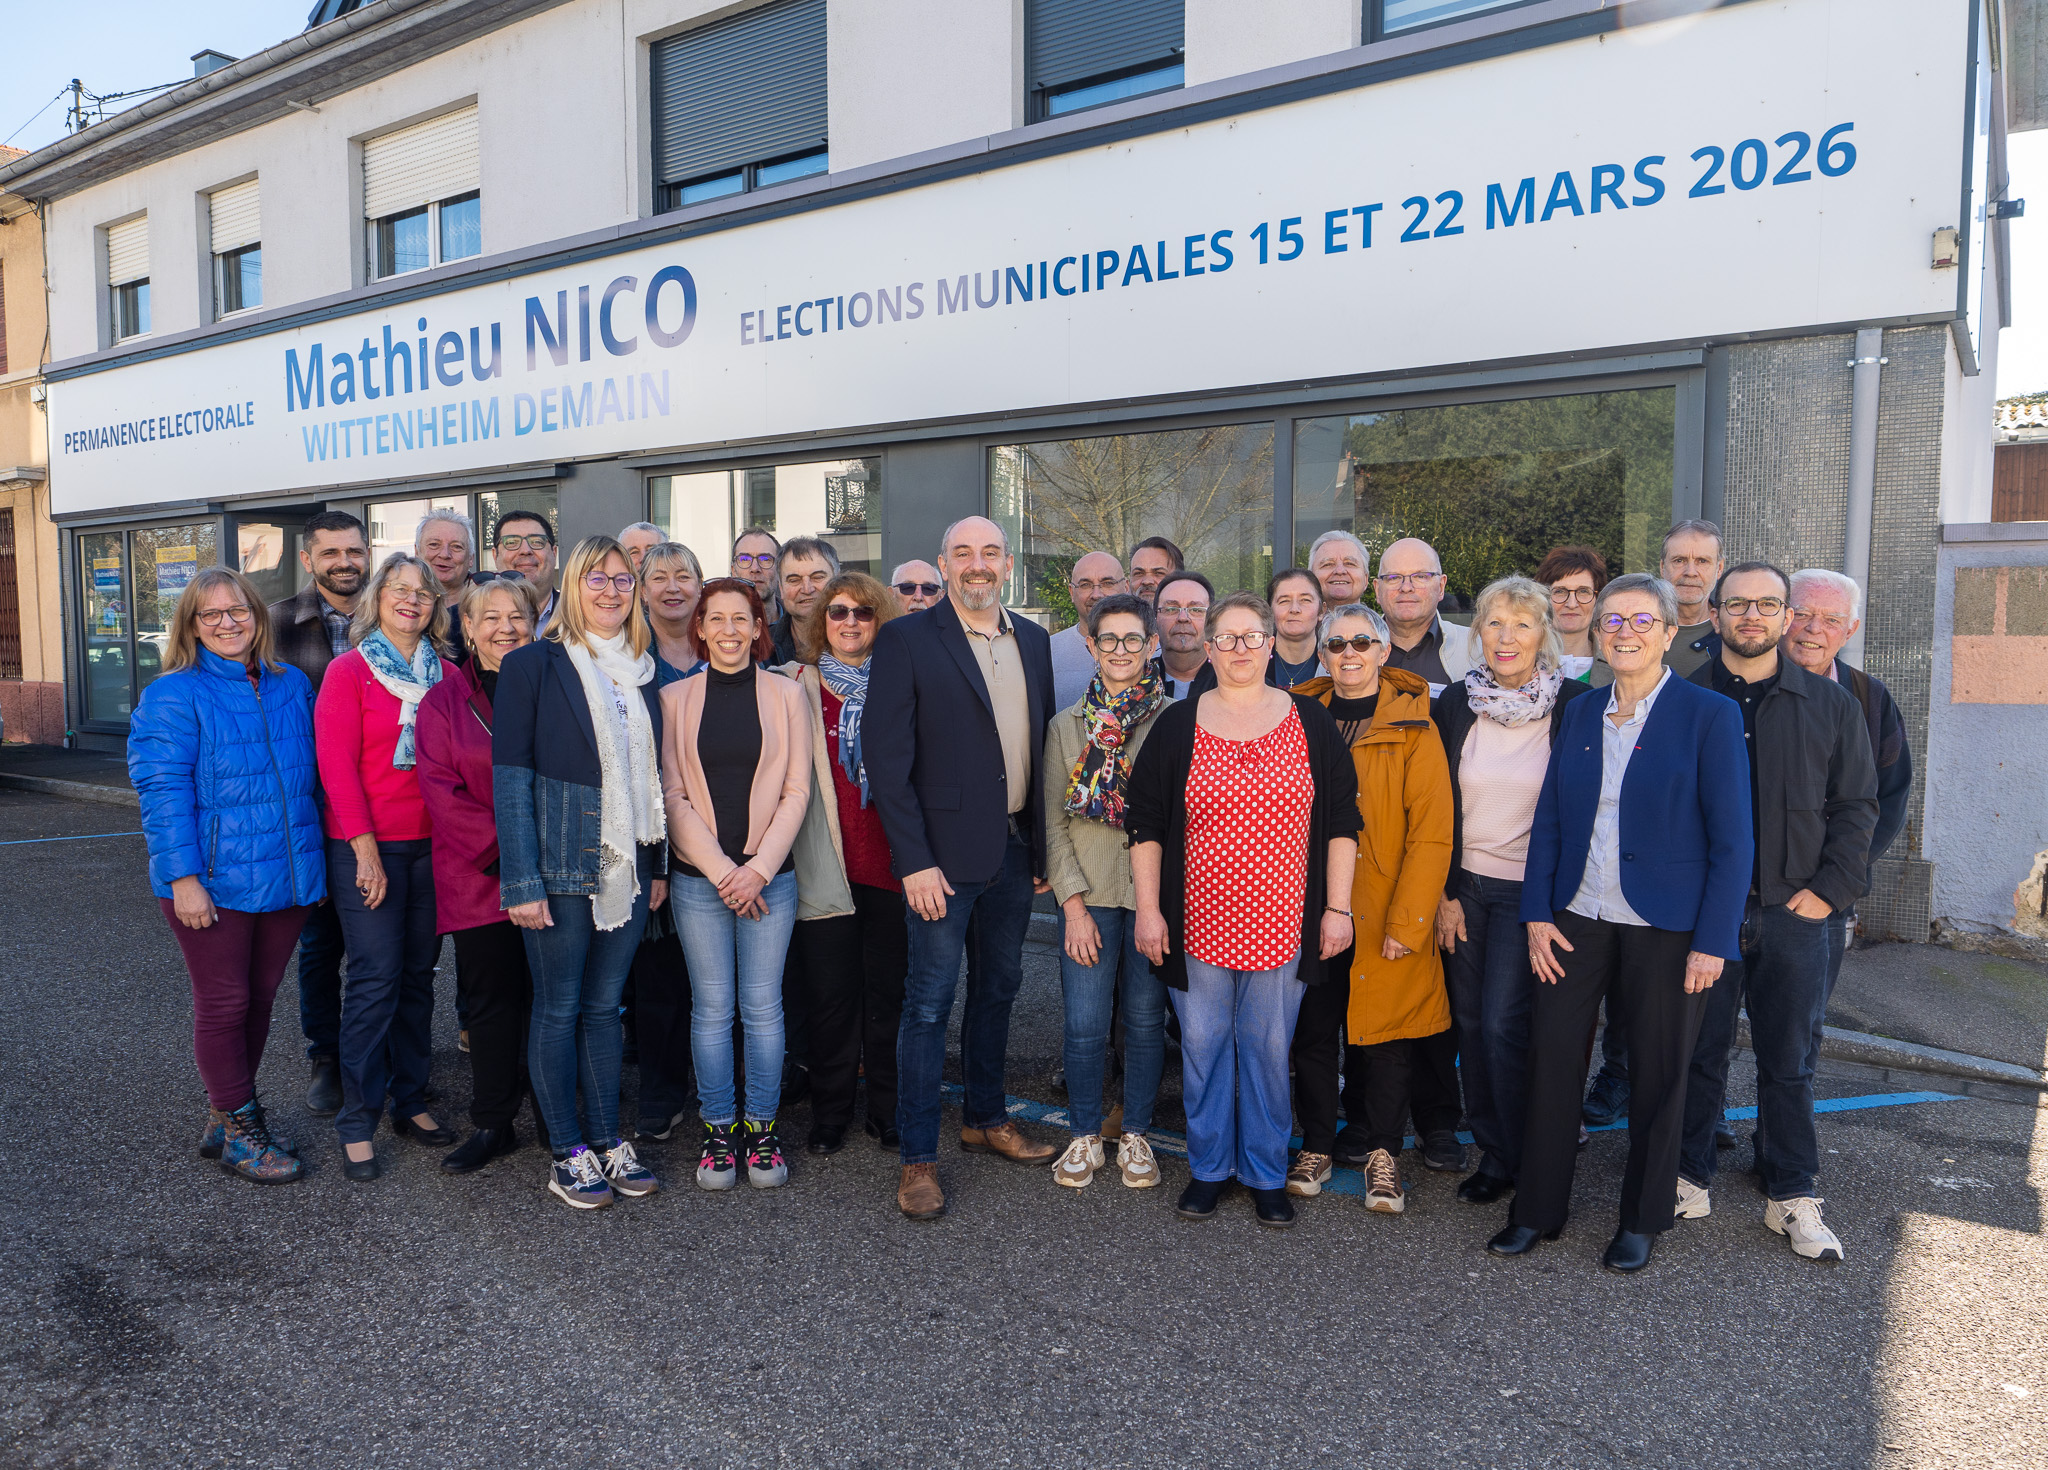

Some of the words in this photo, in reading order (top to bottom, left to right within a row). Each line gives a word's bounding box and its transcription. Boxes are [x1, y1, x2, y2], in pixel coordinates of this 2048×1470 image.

[740, 281, 924, 346] ELECTIONS
[936, 229, 1234, 316] MUNICIPALES
[1249, 215, 1305, 265] 15
[1323, 202, 1384, 256] ET
[1399, 190, 1465, 244] 22
[1485, 155, 1667, 231] MARS
[1688, 121, 1858, 200] 2026
[284, 316, 503, 413] Mathieu
[524, 264, 698, 372] NICO
[64, 418, 156, 455] PERMANENCE
[158, 400, 255, 440] ELECTORALE
[301, 396, 500, 463] WITTENHEIM
[513, 368, 671, 437] DEMAIN
